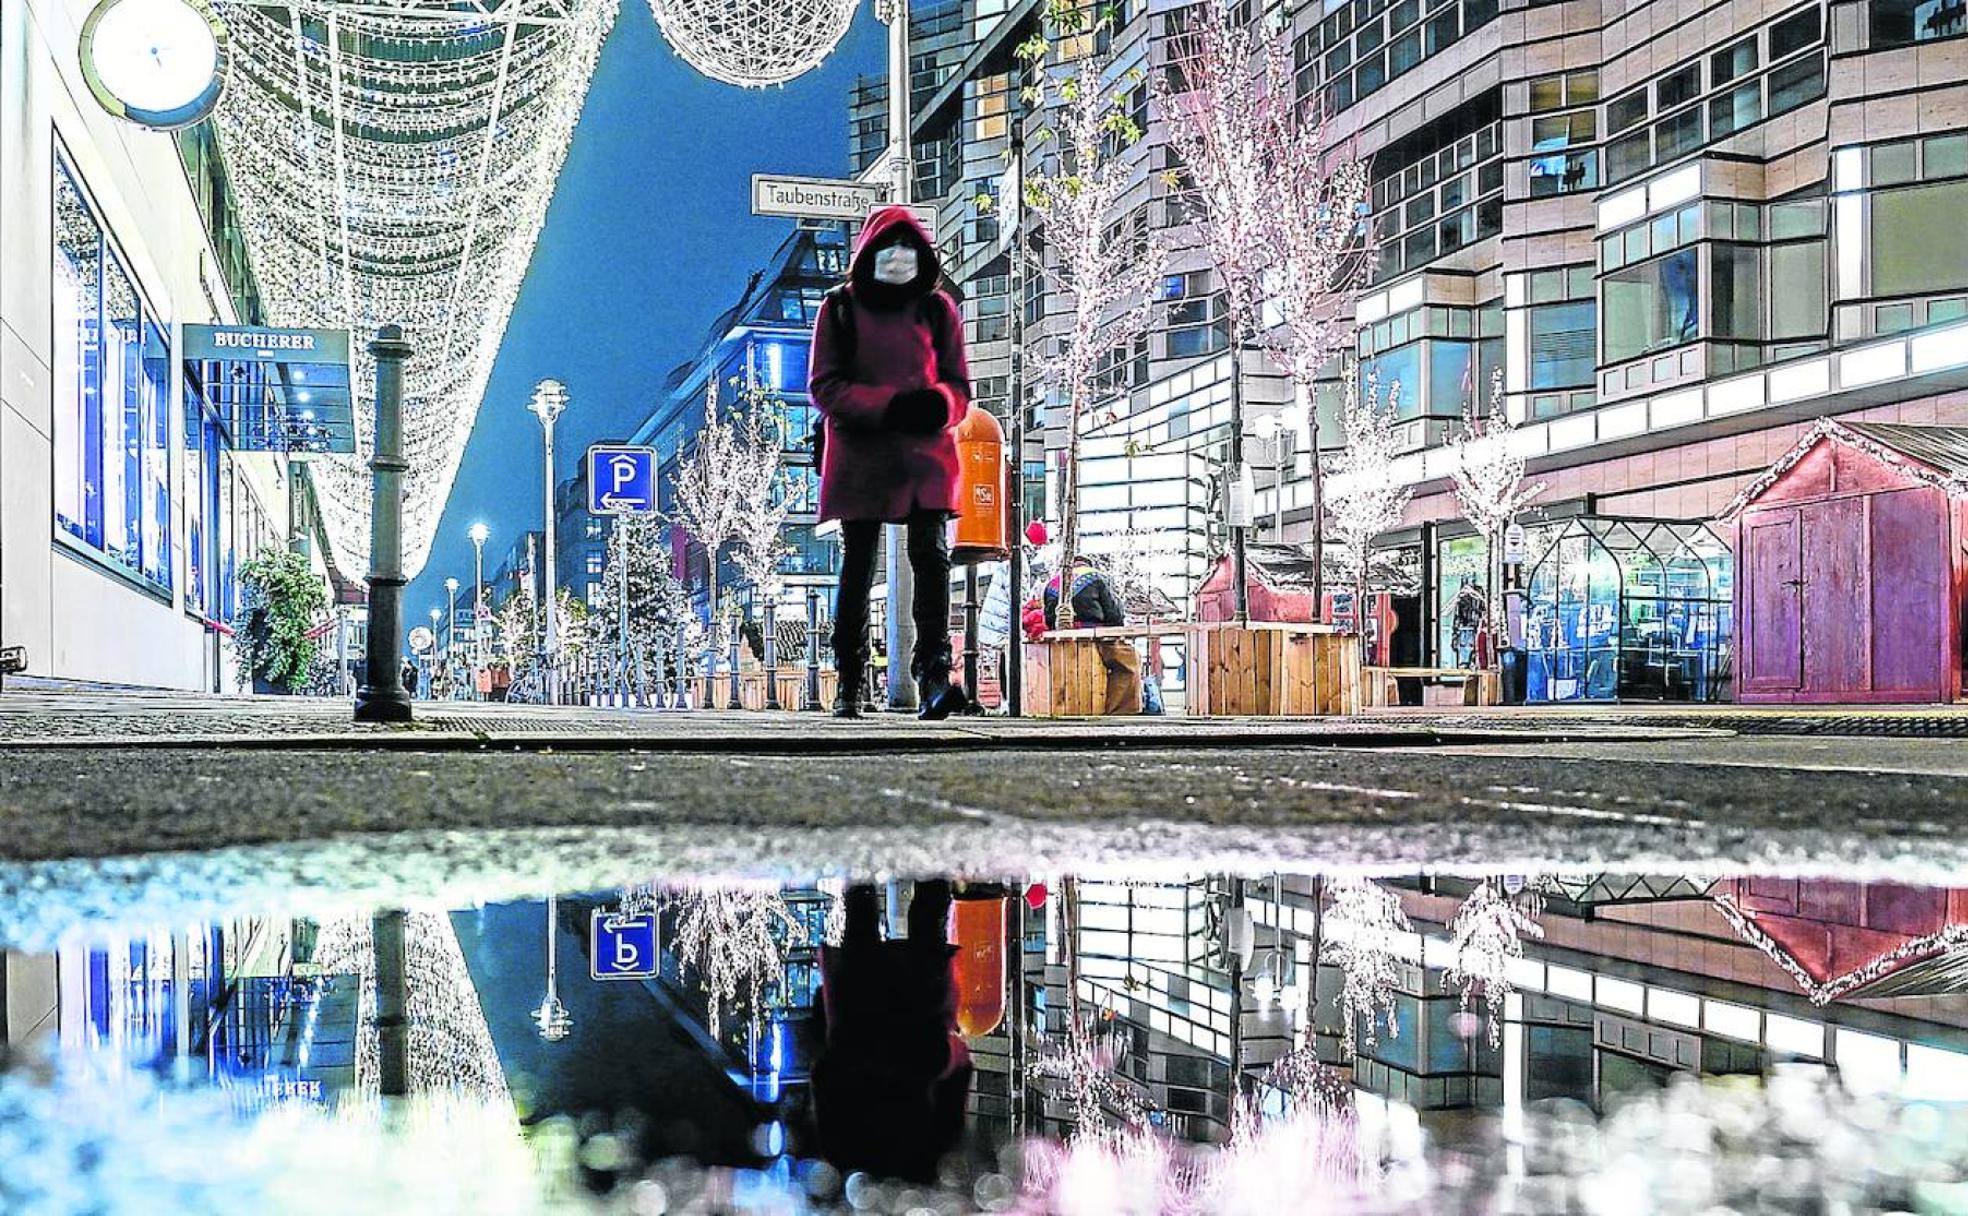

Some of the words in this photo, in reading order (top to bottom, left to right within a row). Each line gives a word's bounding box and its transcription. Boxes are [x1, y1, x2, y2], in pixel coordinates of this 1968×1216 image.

[766, 184, 870, 212] Taubenstraße
[213, 331, 315, 349] BUCHERER
[614, 463, 636, 493] P
